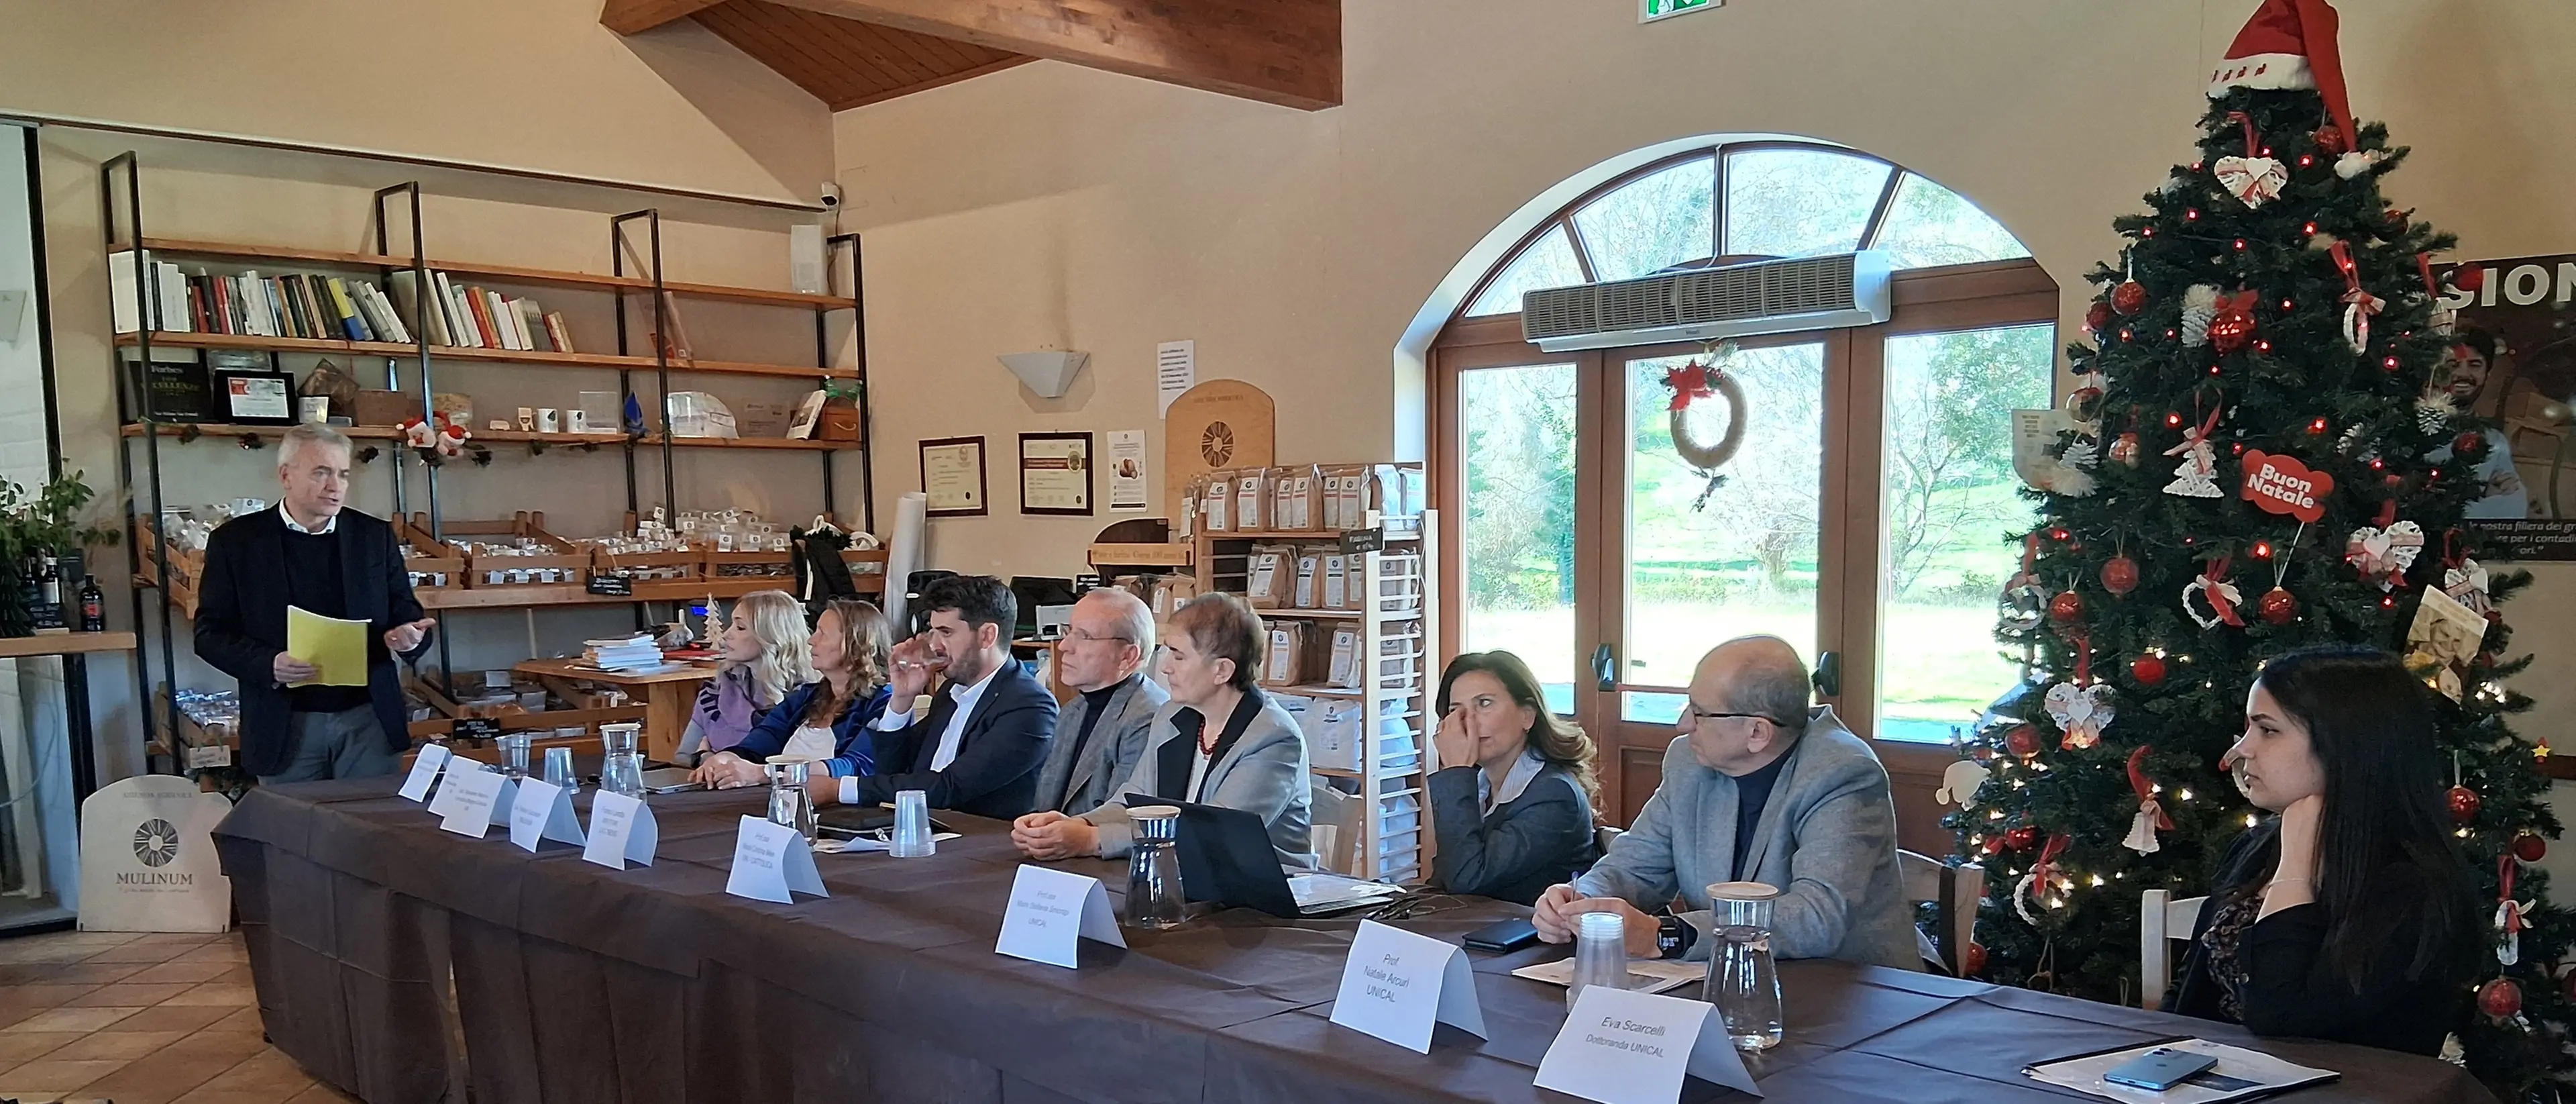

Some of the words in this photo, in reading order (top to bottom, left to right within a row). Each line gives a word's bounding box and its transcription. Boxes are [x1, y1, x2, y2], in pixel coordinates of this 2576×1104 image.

[2259, 463, 2312, 493] Buon
[2247, 473, 2314, 509] Natale
[2510, 535, 2526, 543] per
[116, 872, 193, 885] MULINUM
[1366, 984, 1395, 1003] UNICAL
[1601, 1017, 1621, 1029] Eva
[1622, 1019, 1666, 1037] Scarcelli
[1630, 1042, 1664, 1058] UNICAL
